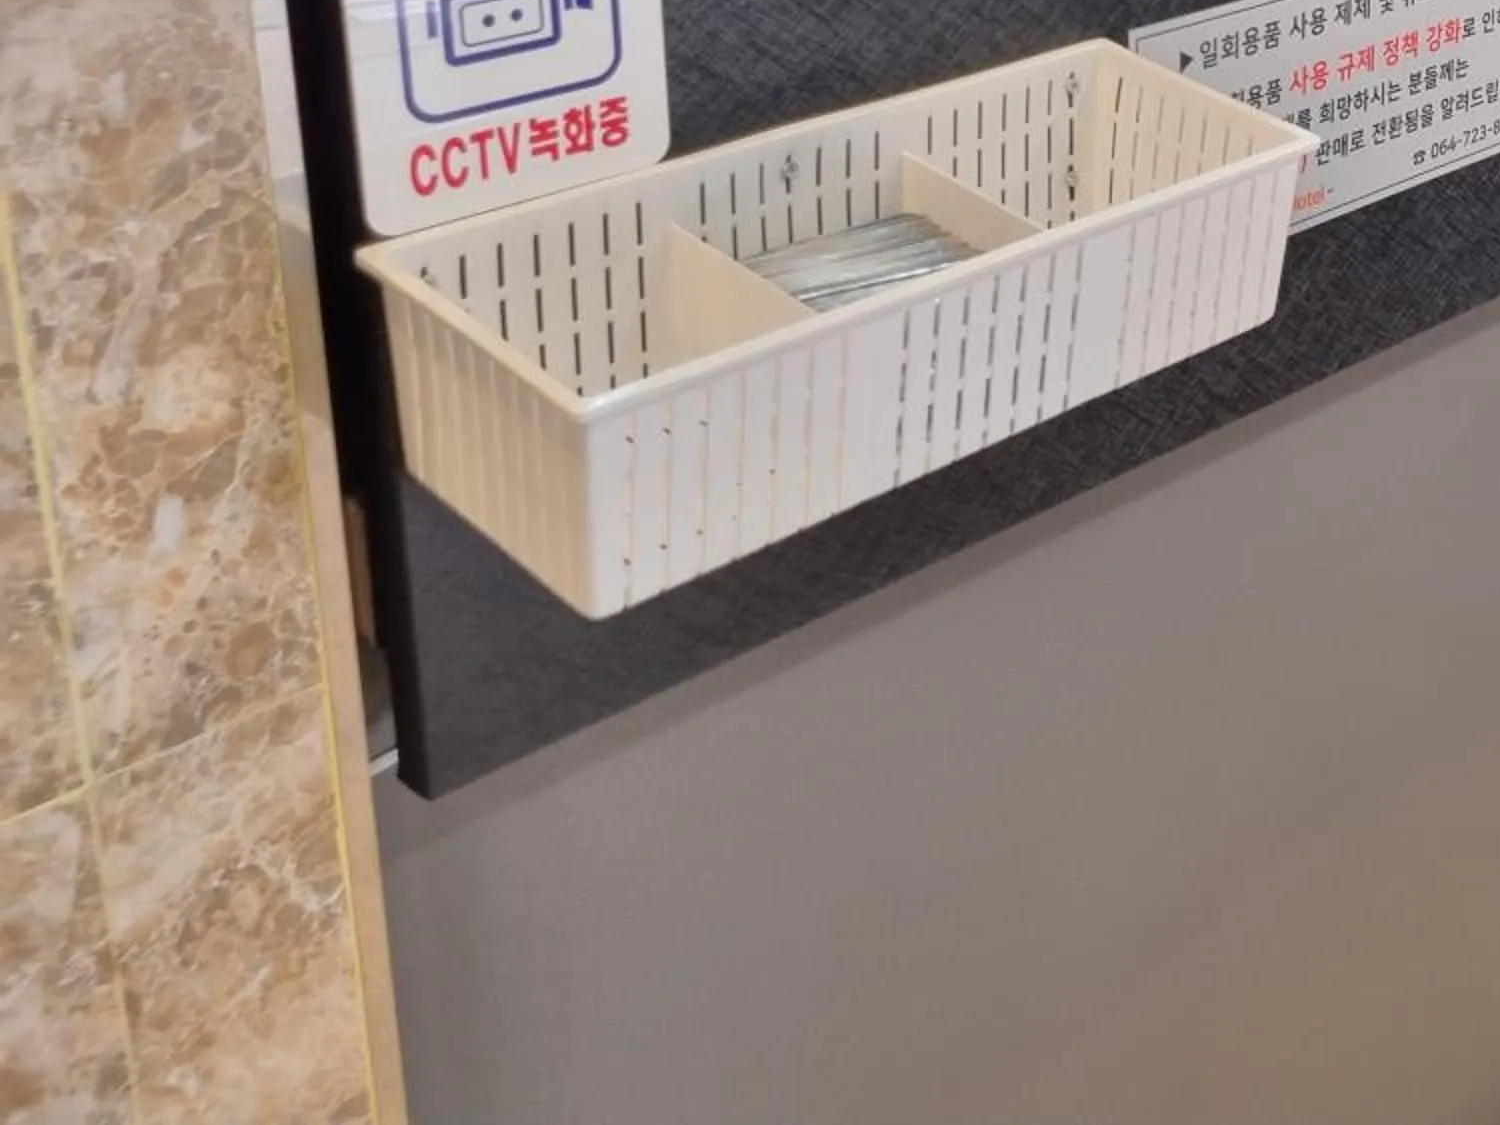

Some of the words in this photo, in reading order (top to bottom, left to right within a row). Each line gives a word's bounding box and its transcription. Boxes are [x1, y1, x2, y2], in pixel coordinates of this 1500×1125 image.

[1199, 20, 1281, 70] 일회용품
[1289, 6, 1327, 40] 사용
[1289, 60, 1329, 94] 사용
[1337, 44, 1376, 82] 규제
[1383, 30, 1419, 66] 정책
[1426, 16, 1476, 52] 강화로
[1319, 81, 1402, 124] 희망하시는
[1315, 129, 1367, 167] 판매로
[1371, 103, 1435, 146] 전환됨을
